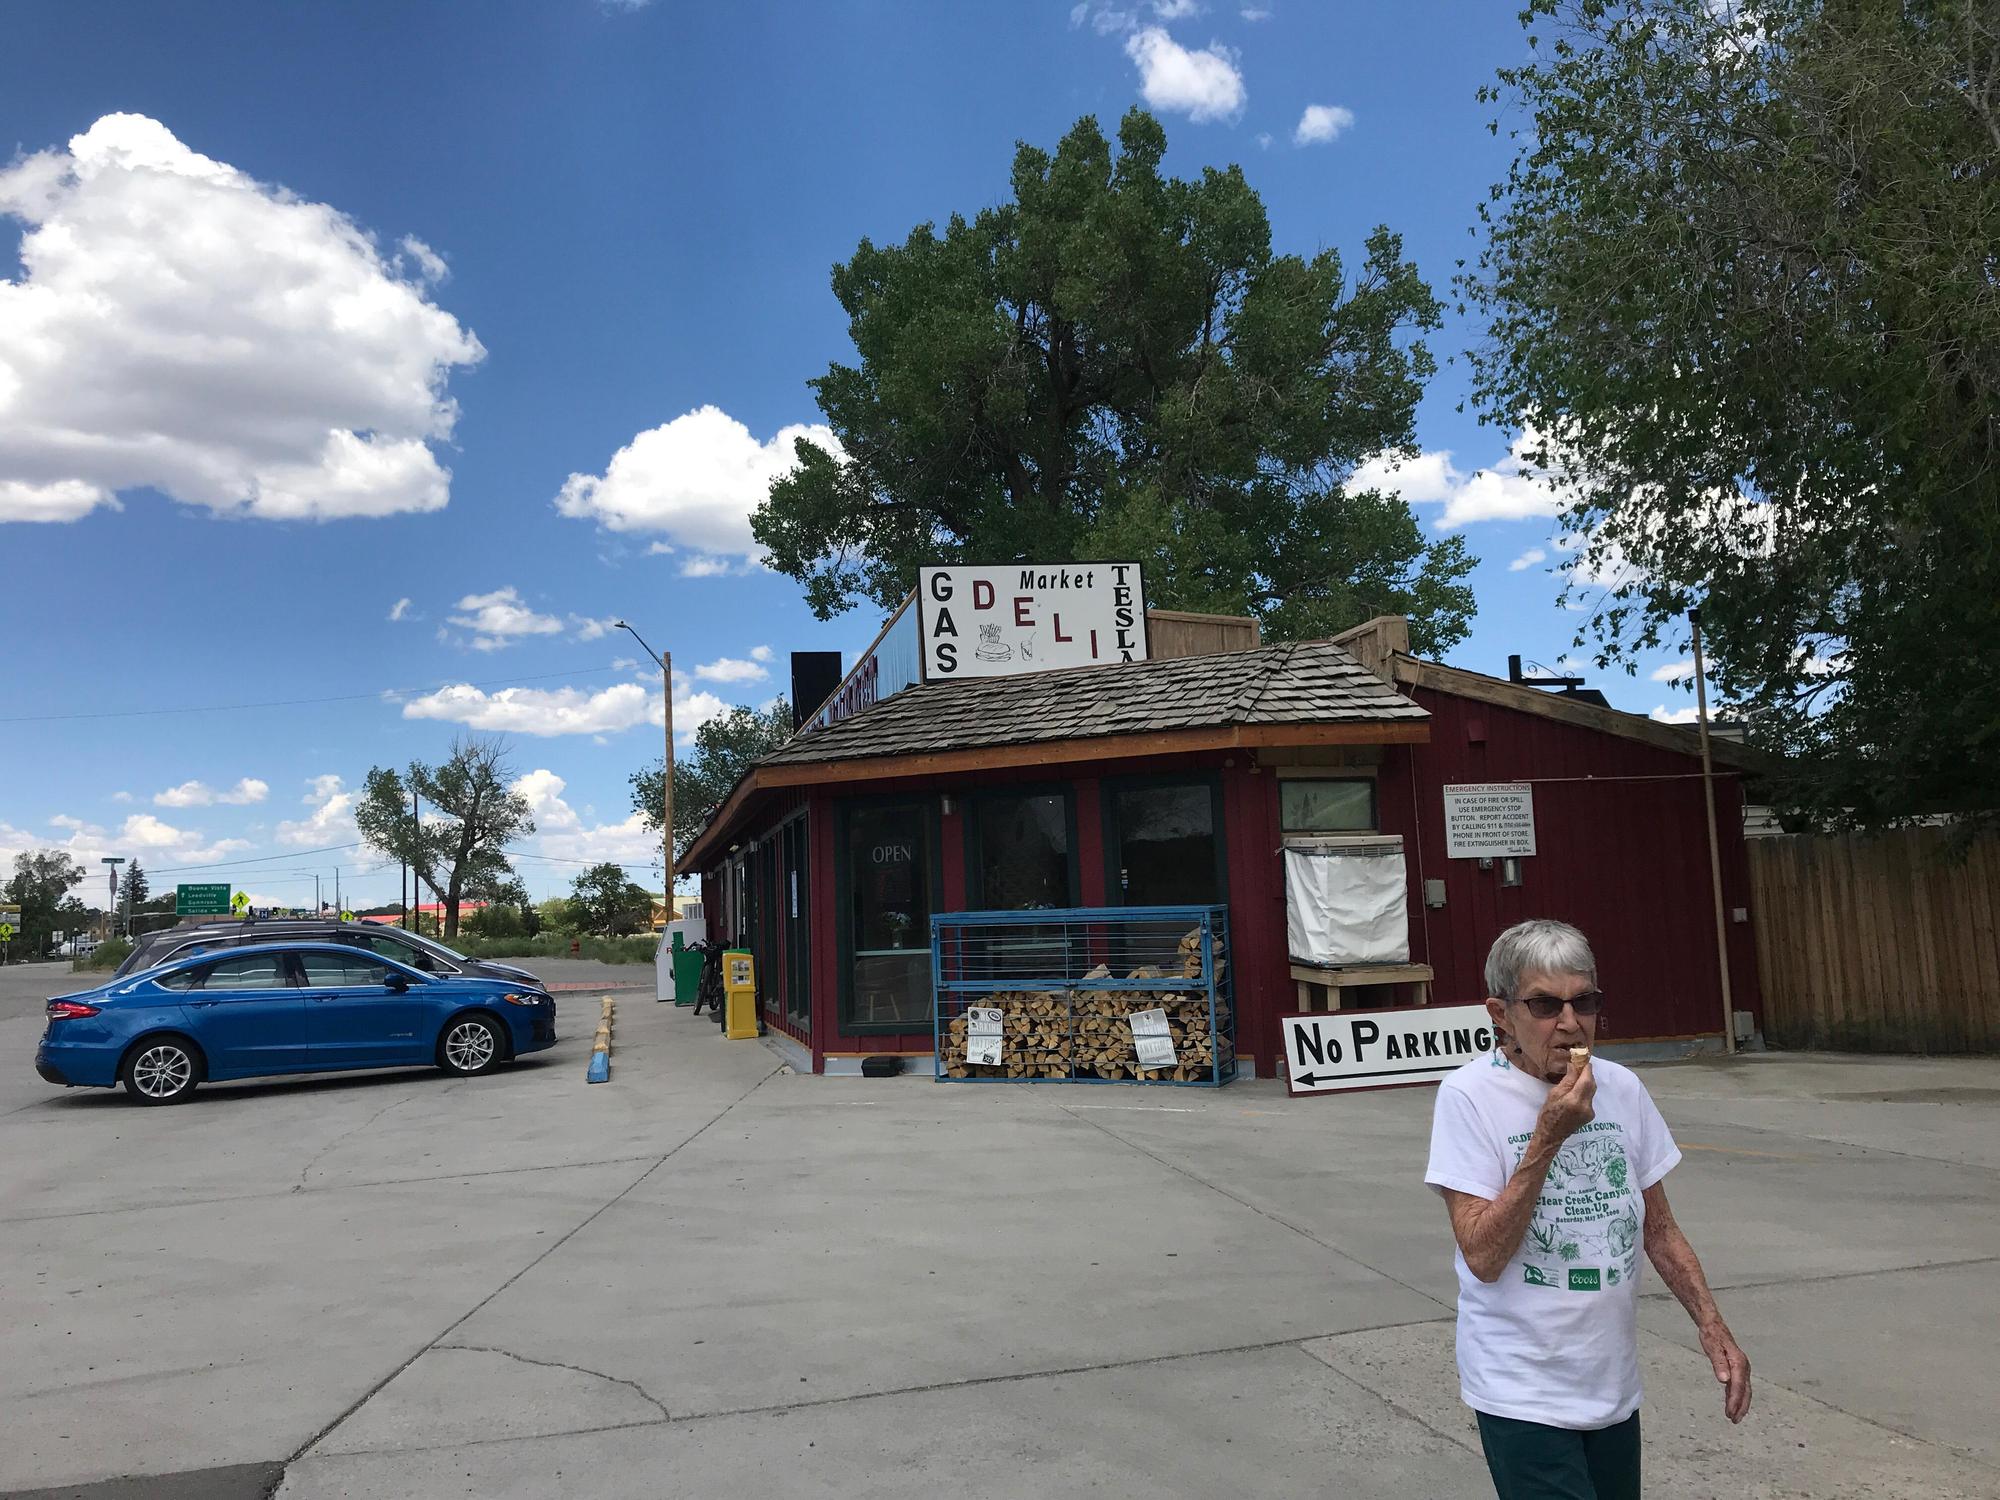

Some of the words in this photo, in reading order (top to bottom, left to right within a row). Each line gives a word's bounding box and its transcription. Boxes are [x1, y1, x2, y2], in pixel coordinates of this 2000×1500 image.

[1019, 568, 1094, 590] Market
[930, 571, 959, 673] GAS
[972, 579, 1098, 659] DELI
[1486, 784, 1530, 792] INSTRUCTIONS
[1471, 805, 1506, 813] EMERGENCY
[1467, 840, 1509, 848] EXTINGUISHER
[872, 845, 912, 863] OPEN
[1507, 1130, 1534, 1144] GOLDE
[1565, 1194, 1593, 1206] Creek
[1594, 1186, 1631, 1201] Canyon
[1564, 1202, 1610, 1216] Clean-Up
[1571, 1273, 1598, 1285] Coors
